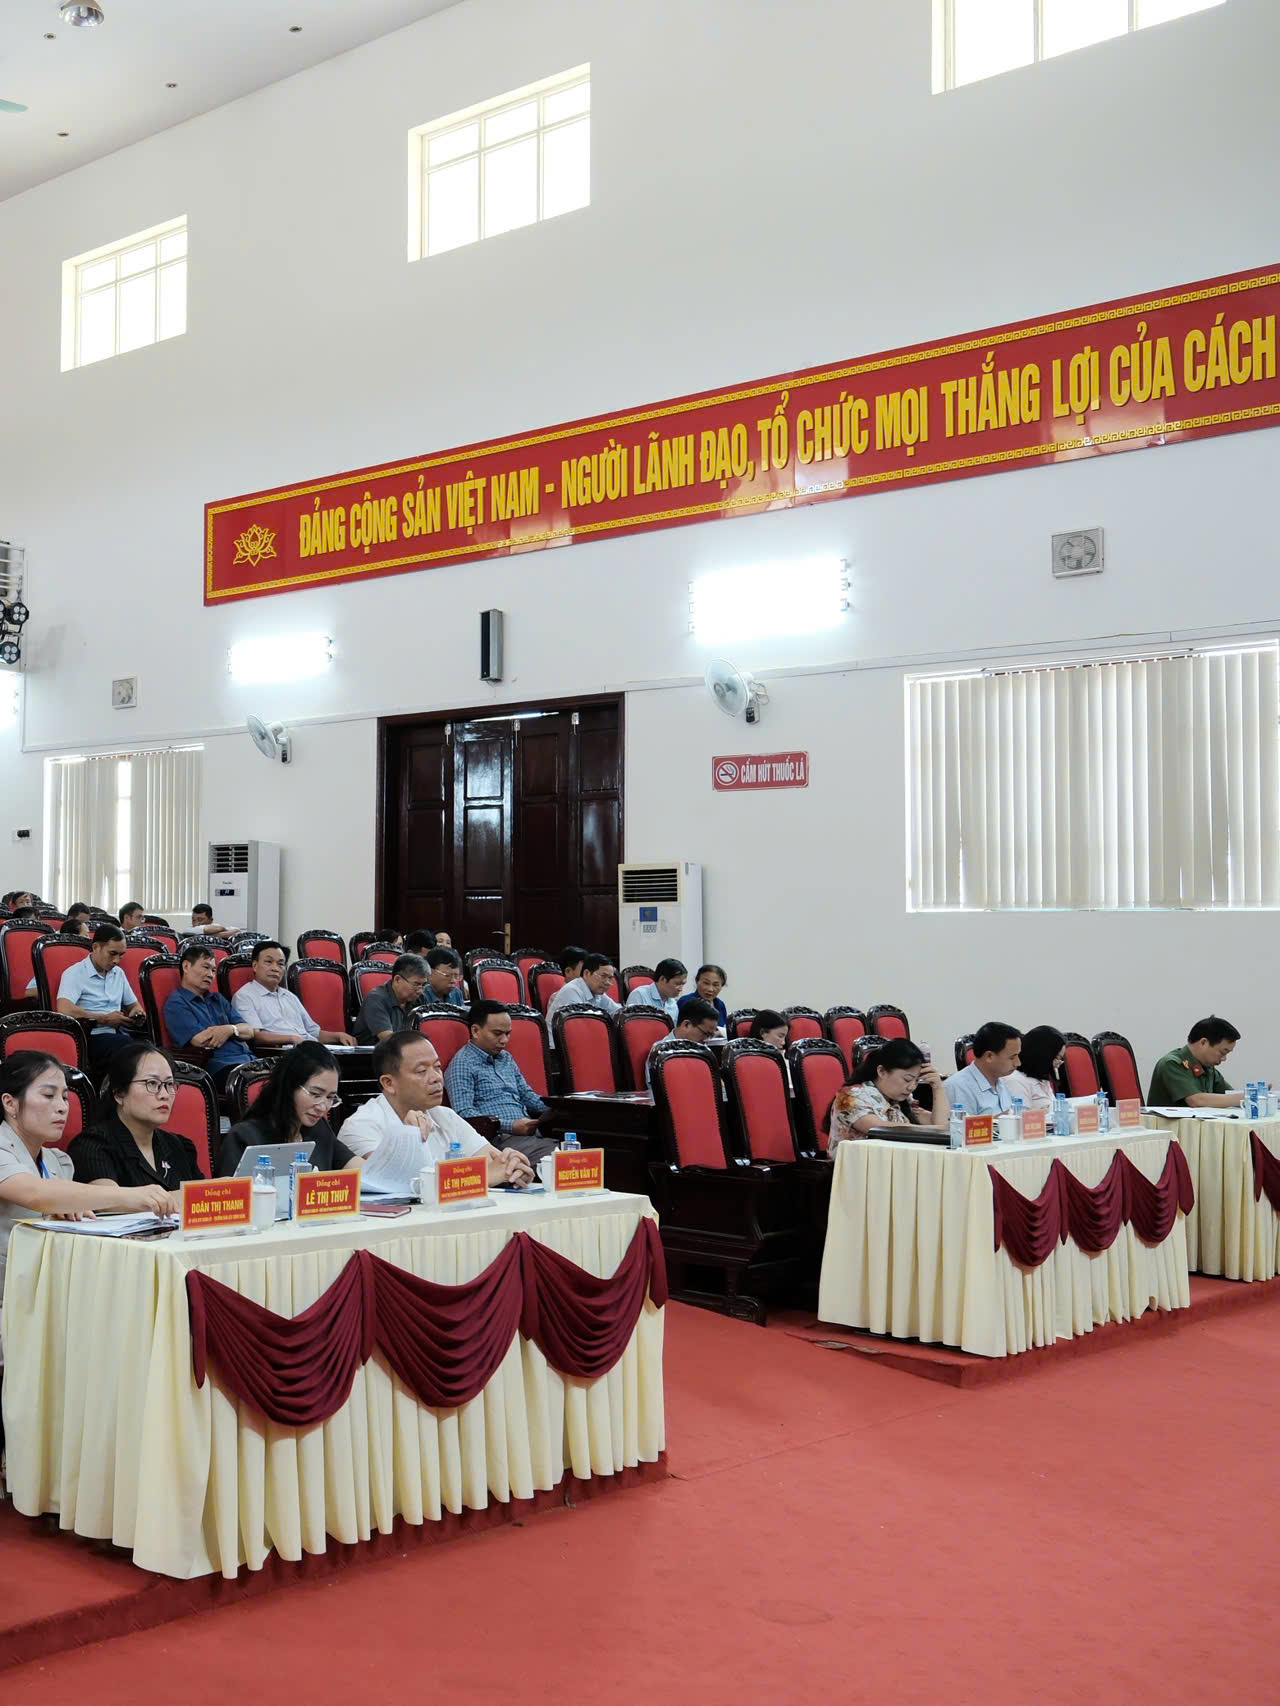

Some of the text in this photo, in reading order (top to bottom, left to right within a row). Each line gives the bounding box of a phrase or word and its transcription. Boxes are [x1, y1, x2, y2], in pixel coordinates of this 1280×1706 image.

[298, 495, 347, 558] ĐẢNG
[349, 490, 399, 554] CỘNG
[402, 474, 442, 537] SẢN
[445, 469, 488, 536] VIỆT
[490, 464, 541, 523] NAM
[560, 437, 629, 509] NGƯỜI
[632, 431, 696, 496] LÃNH
[699, 422, 756, 489] ĐẠO,
[756, 390, 790, 473] TỔ
[796, 391, 870, 464] CHỨC
[874, 384, 929, 457] MỌI
[940, 351, 1041, 438] THẮNG
[1052, 344, 1101, 425] LỢI
[1108, 319, 1177, 407] CỦA
[1183, 311, 1278, 393] CÁCH
[741, 755, 805, 783] CẤM HÚT THUỐC LÁ
